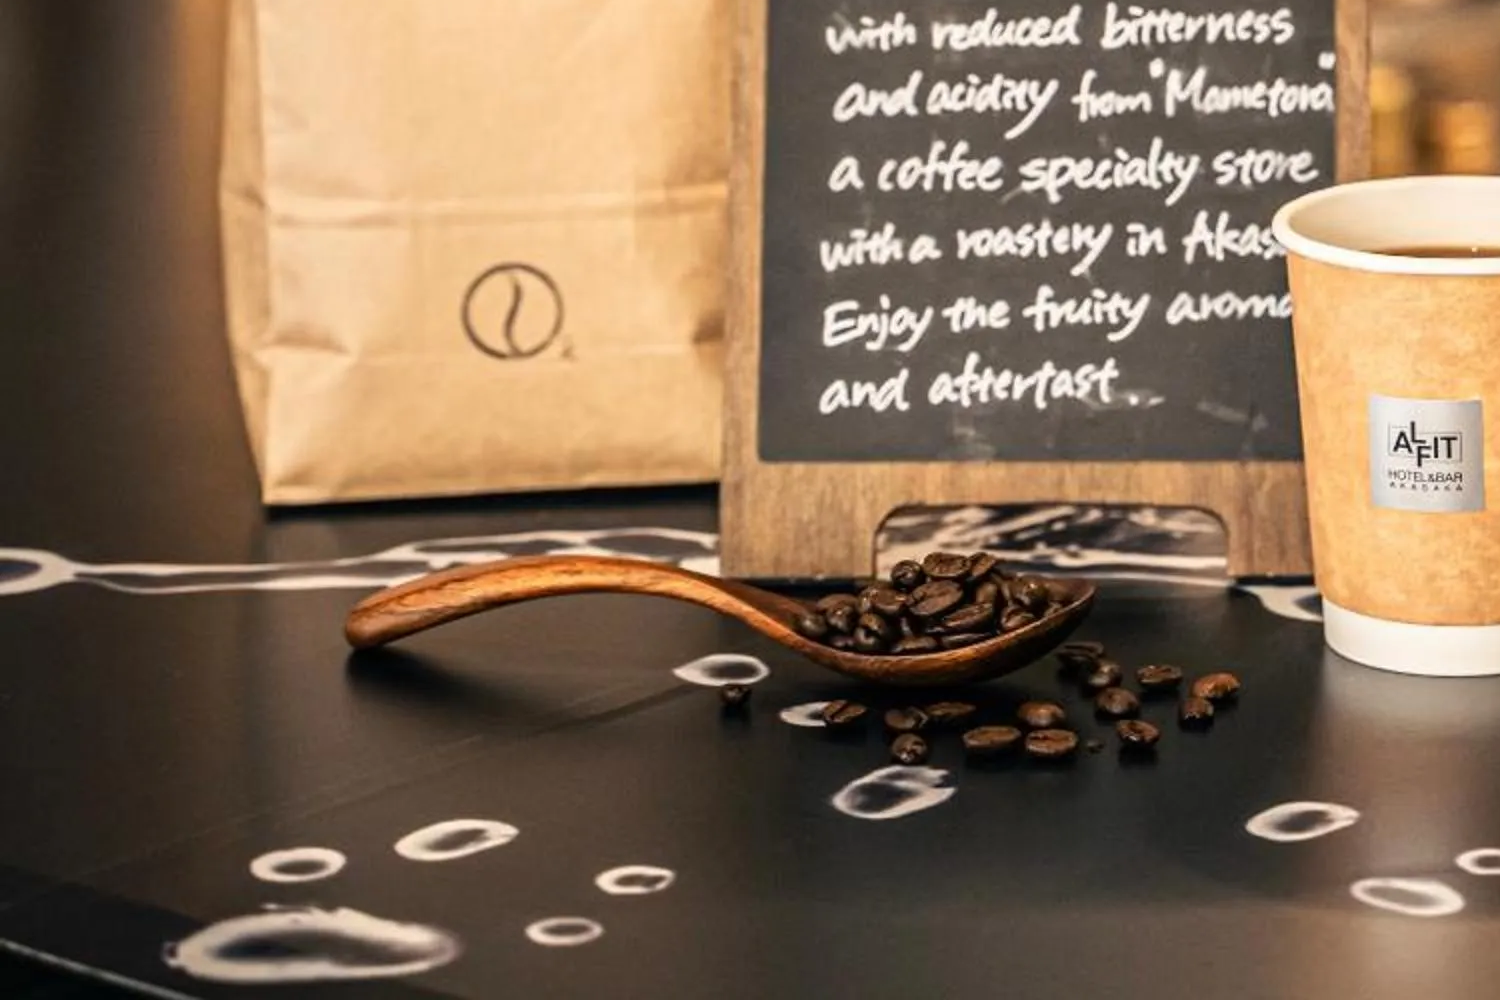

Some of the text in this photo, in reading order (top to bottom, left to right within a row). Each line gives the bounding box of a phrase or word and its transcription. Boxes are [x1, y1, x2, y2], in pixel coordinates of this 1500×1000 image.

[825, 1, 1295, 54] with reduced bitterness
[832, 70, 923, 122] and
[925, 73, 1059, 140] acidity
[1070, 69, 1153, 123] from
[828, 136, 1319, 207] a coffee specialty store
[819, 221, 902, 273] with
[907, 234, 943, 264] a
[956, 219, 1113, 277] roastery
[1126, 222, 1167, 257] in
[822, 294, 935, 353] Enjoy
[941, 296, 1011, 333] the
[1021, 284, 1151, 343] fruity
[818, 367, 910, 415] and
[1392, 420, 1458, 467] ALFIT
[1388, 469, 1463, 483] HOTEL&BAR
